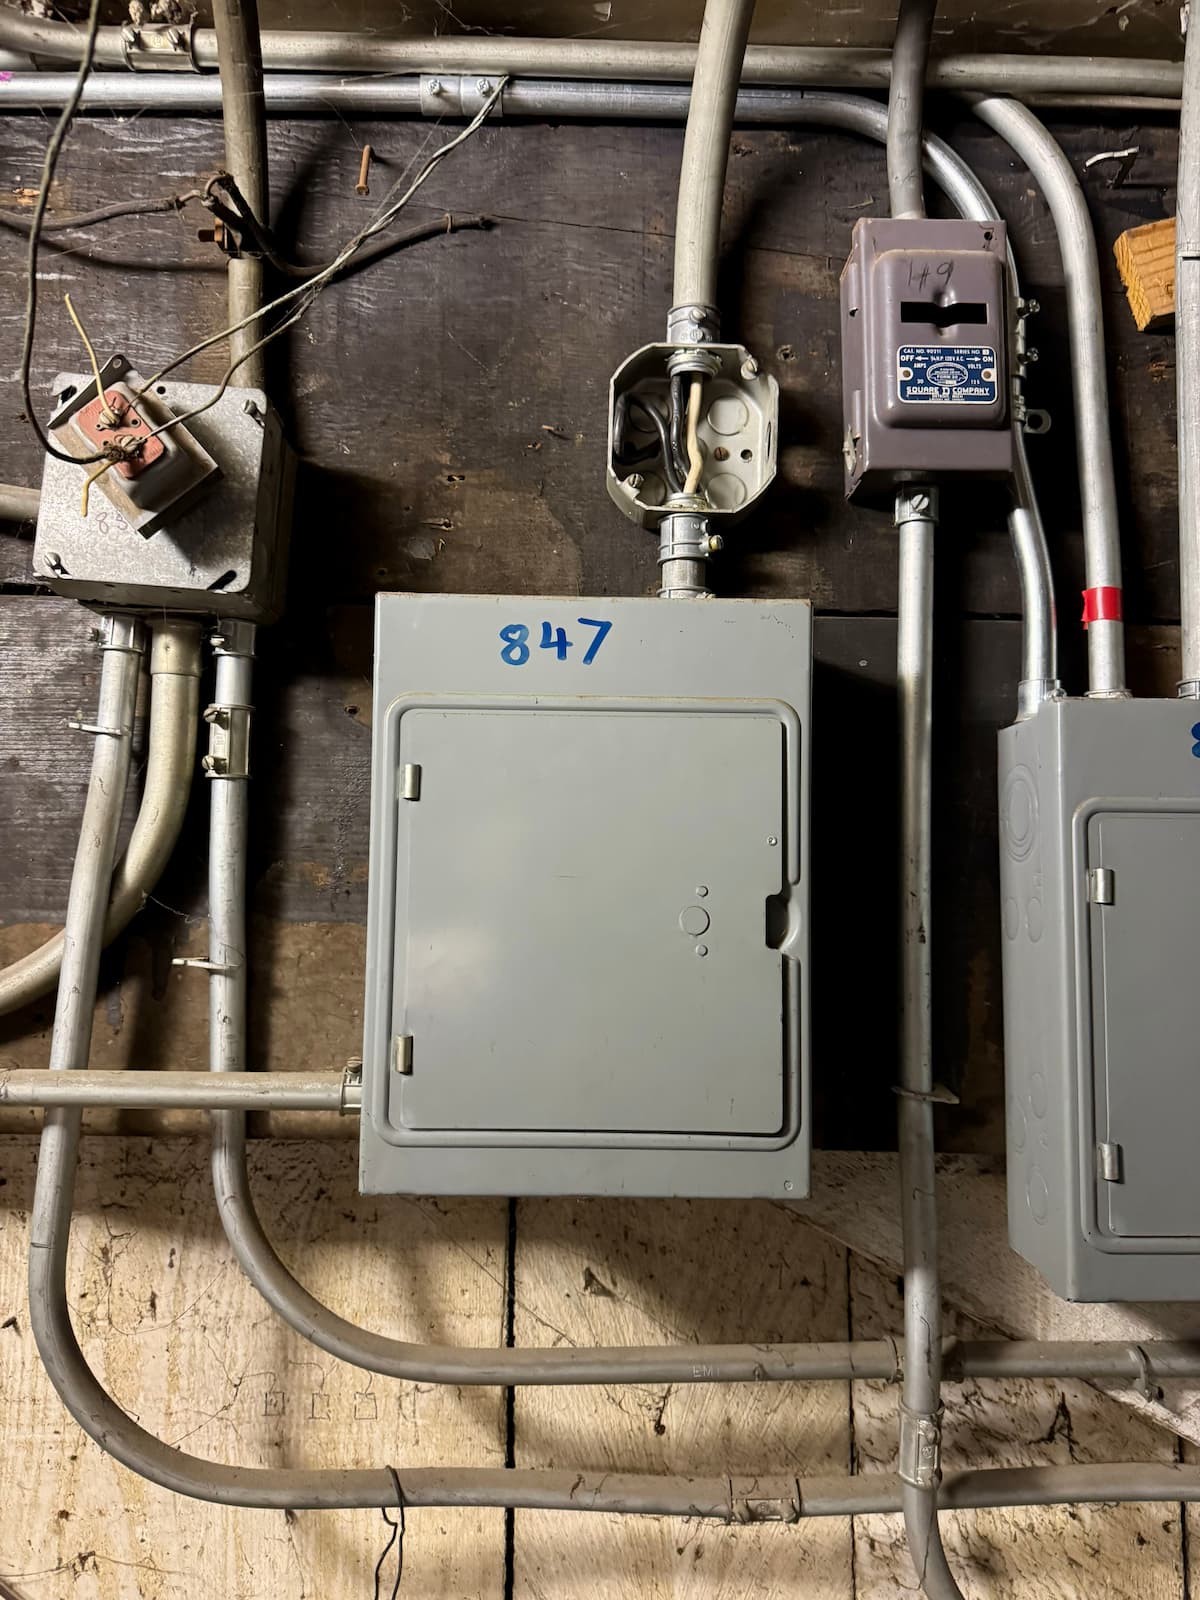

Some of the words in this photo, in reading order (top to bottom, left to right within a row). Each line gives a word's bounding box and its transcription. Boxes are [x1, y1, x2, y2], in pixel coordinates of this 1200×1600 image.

[906, 386, 939, 395] SQUARE
[942, 386, 950, 396] D
[951, 387, 990, 396] COMPANY
[499, 617, 613, 666] 847
